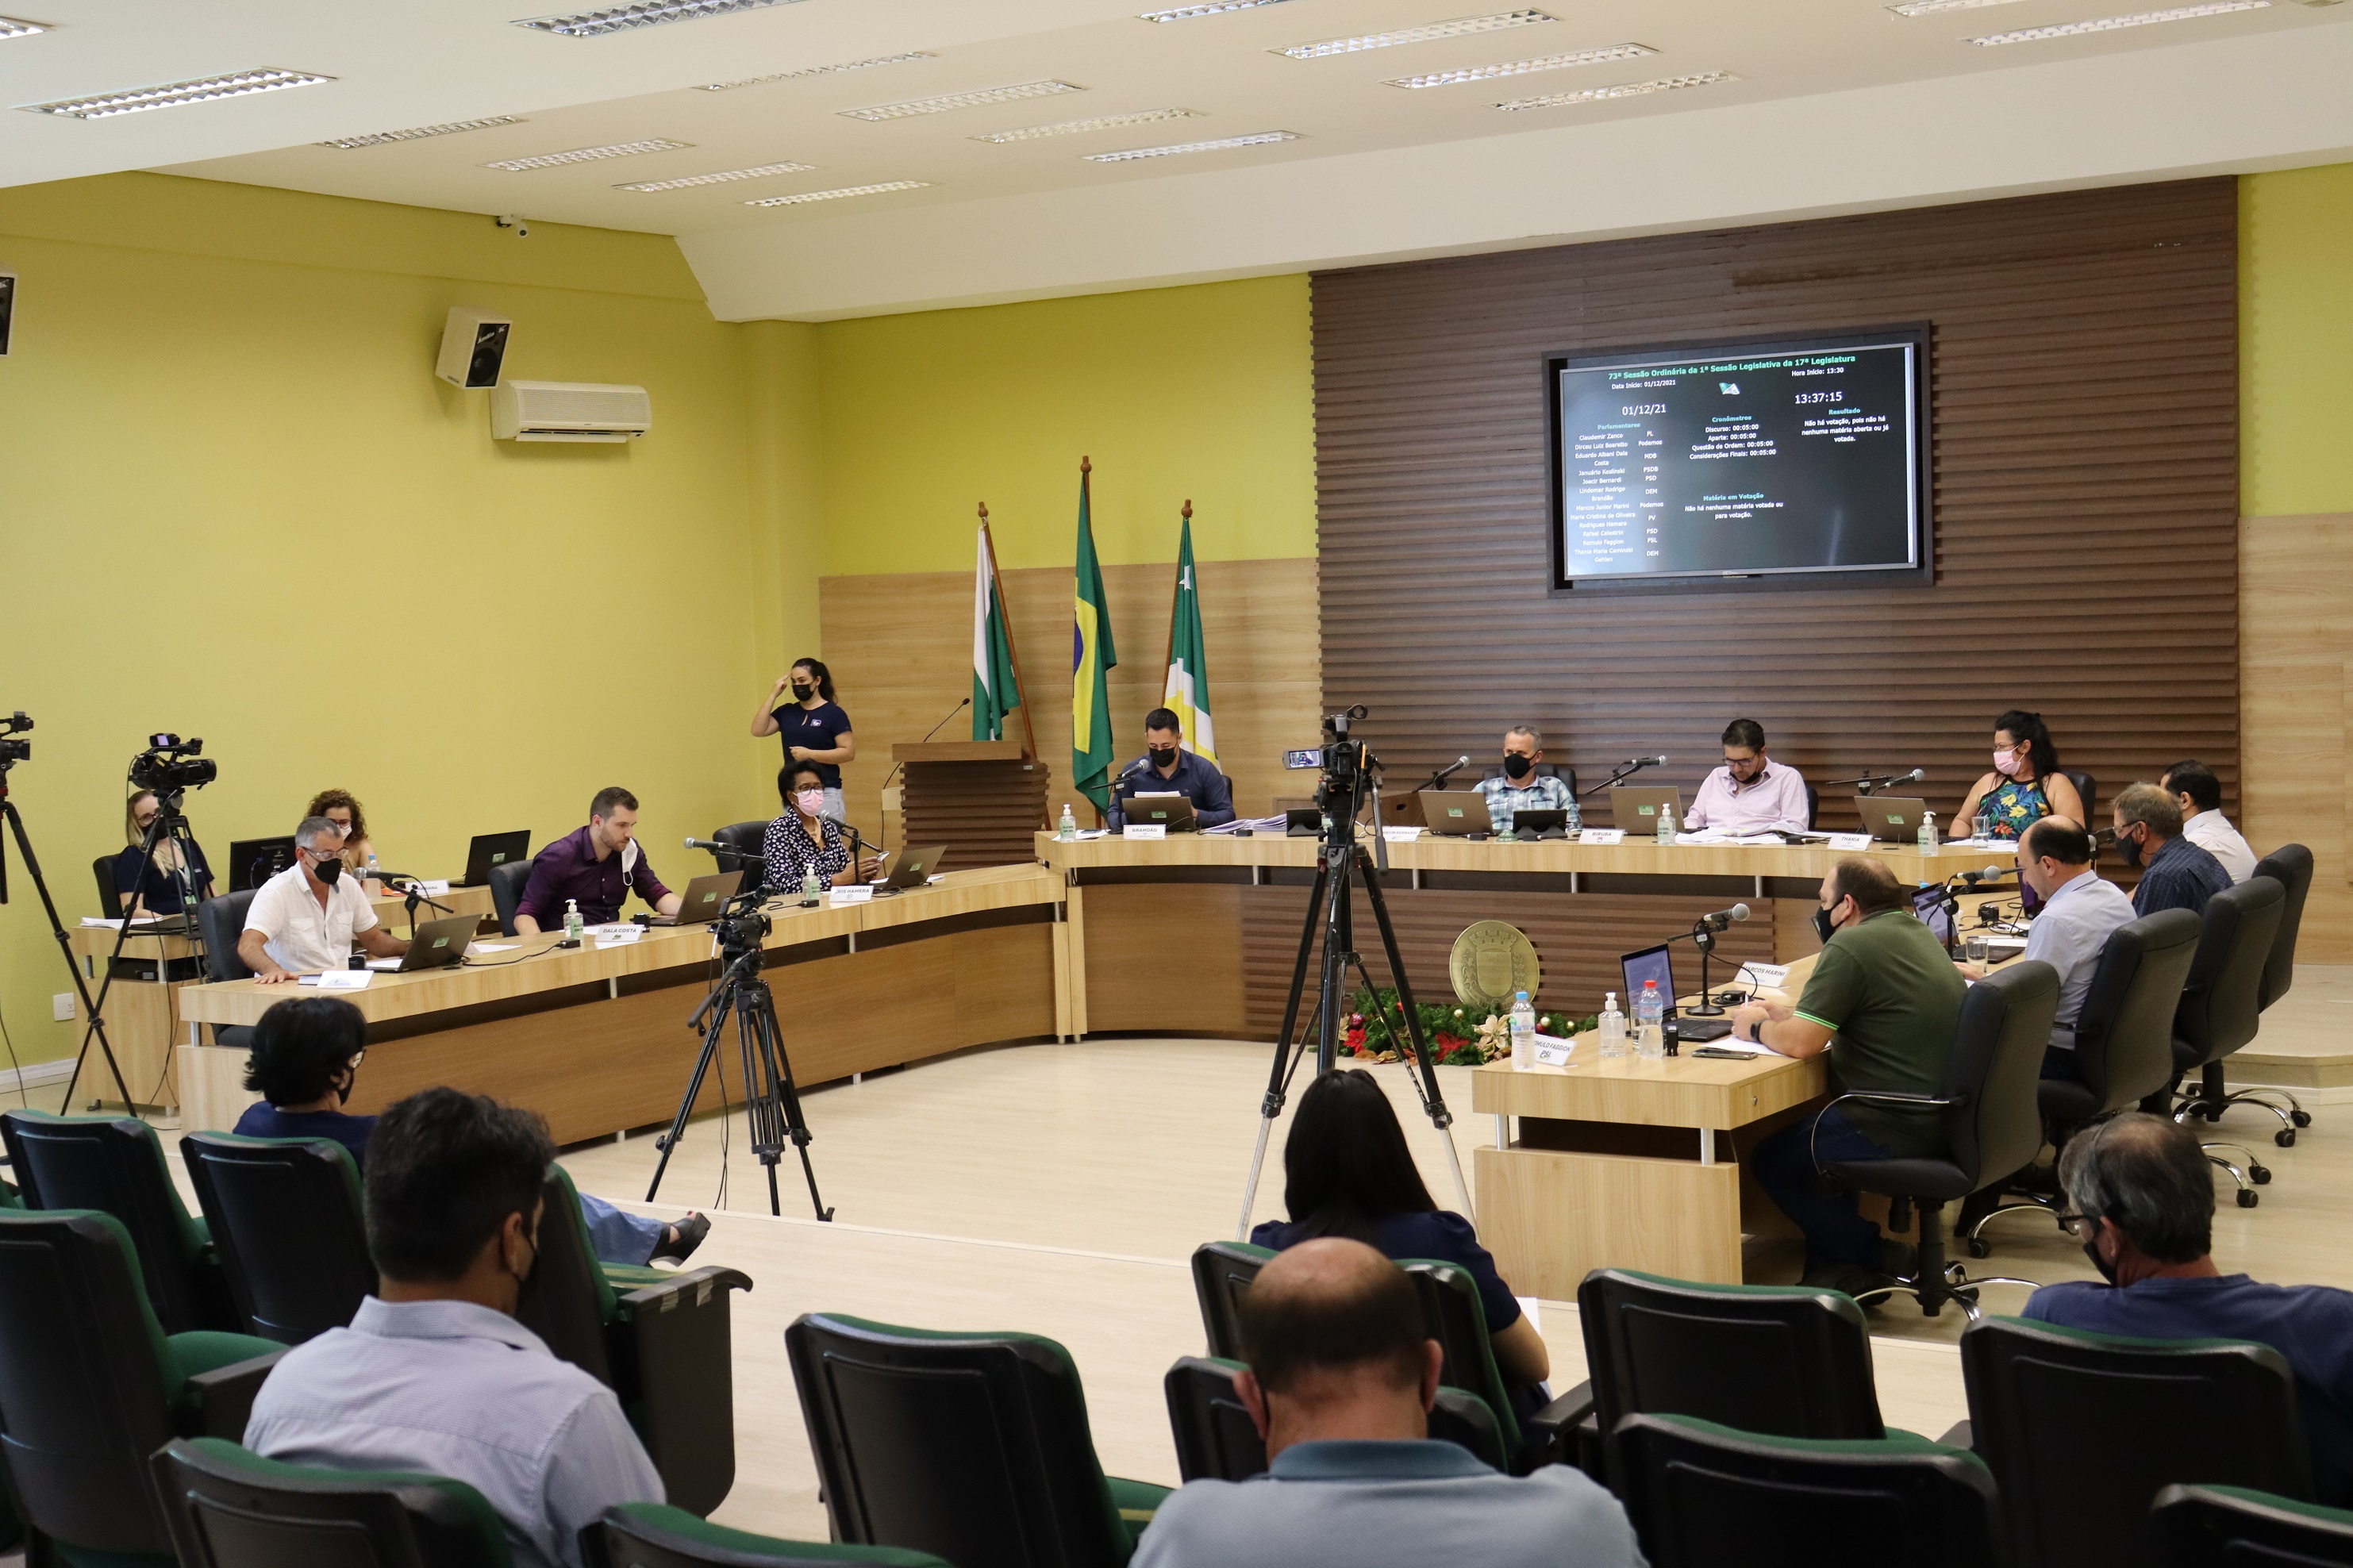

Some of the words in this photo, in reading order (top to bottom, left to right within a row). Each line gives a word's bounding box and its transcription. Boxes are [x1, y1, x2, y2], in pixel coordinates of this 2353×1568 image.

[1651, 367, 1686, 376] Ordinária
[1710, 363, 1737, 372] Sessão
[1740, 360, 1780, 371] Legislativa
[1811, 355, 1855, 364] Legislatura
[1794, 391, 1843, 405] 13:37:15
[1622, 404, 1667, 416] 01/12/21
[1765, 968, 1786, 977] MARINI
[1550, 1043, 1572, 1052] FAGGION
